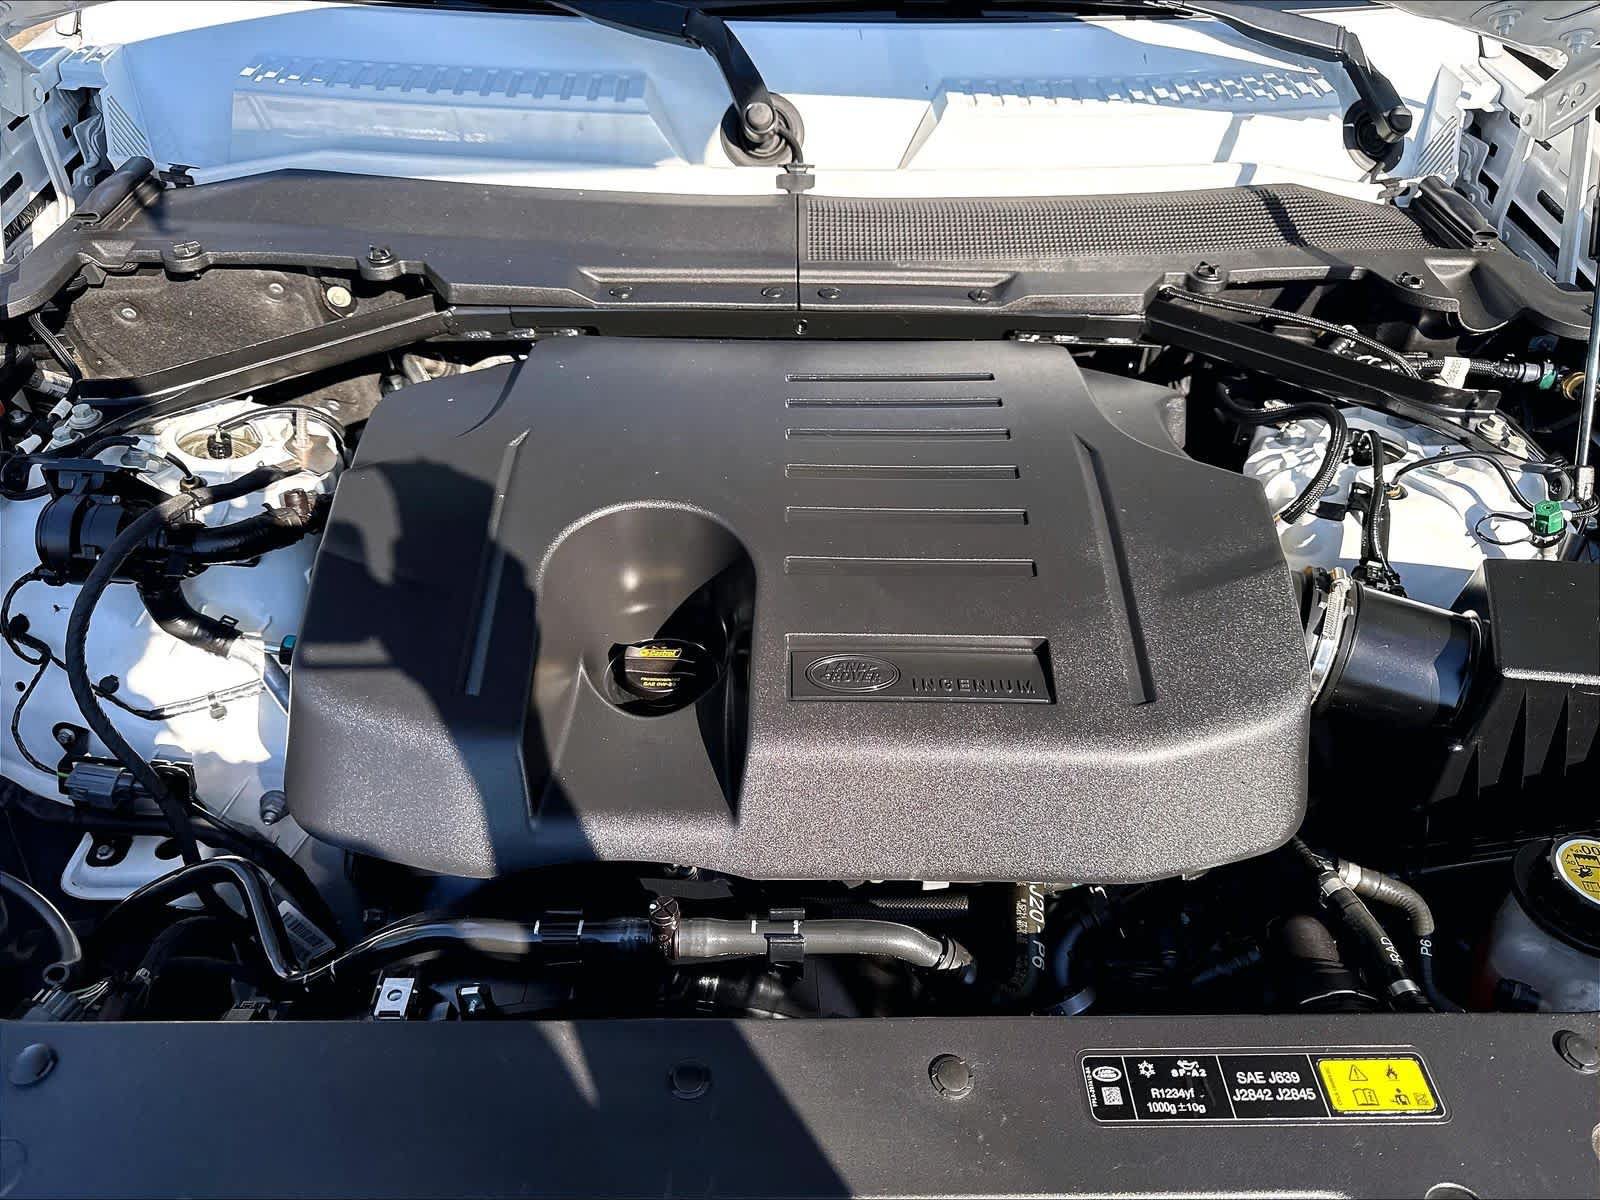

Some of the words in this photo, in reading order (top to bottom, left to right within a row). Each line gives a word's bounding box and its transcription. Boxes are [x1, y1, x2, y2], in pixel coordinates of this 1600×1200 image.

[912, 678, 1037, 694] INGENIUM
[1029, 881, 1045, 923] J20
[1420, 939, 1433, 957] P6
[1236, 1071, 1266, 1084] SAE
[1268, 1071, 1300, 1083] J639
[1150, 1088, 1195, 1100] R1234yf
[1232, 1088, 1273, 1101] J2842
[1275, 1087, 1316, 1100] J2845
[1147, 1102, 1177, 1114] 1000g
[1178, 1102, 1206, 1114] ±10g
